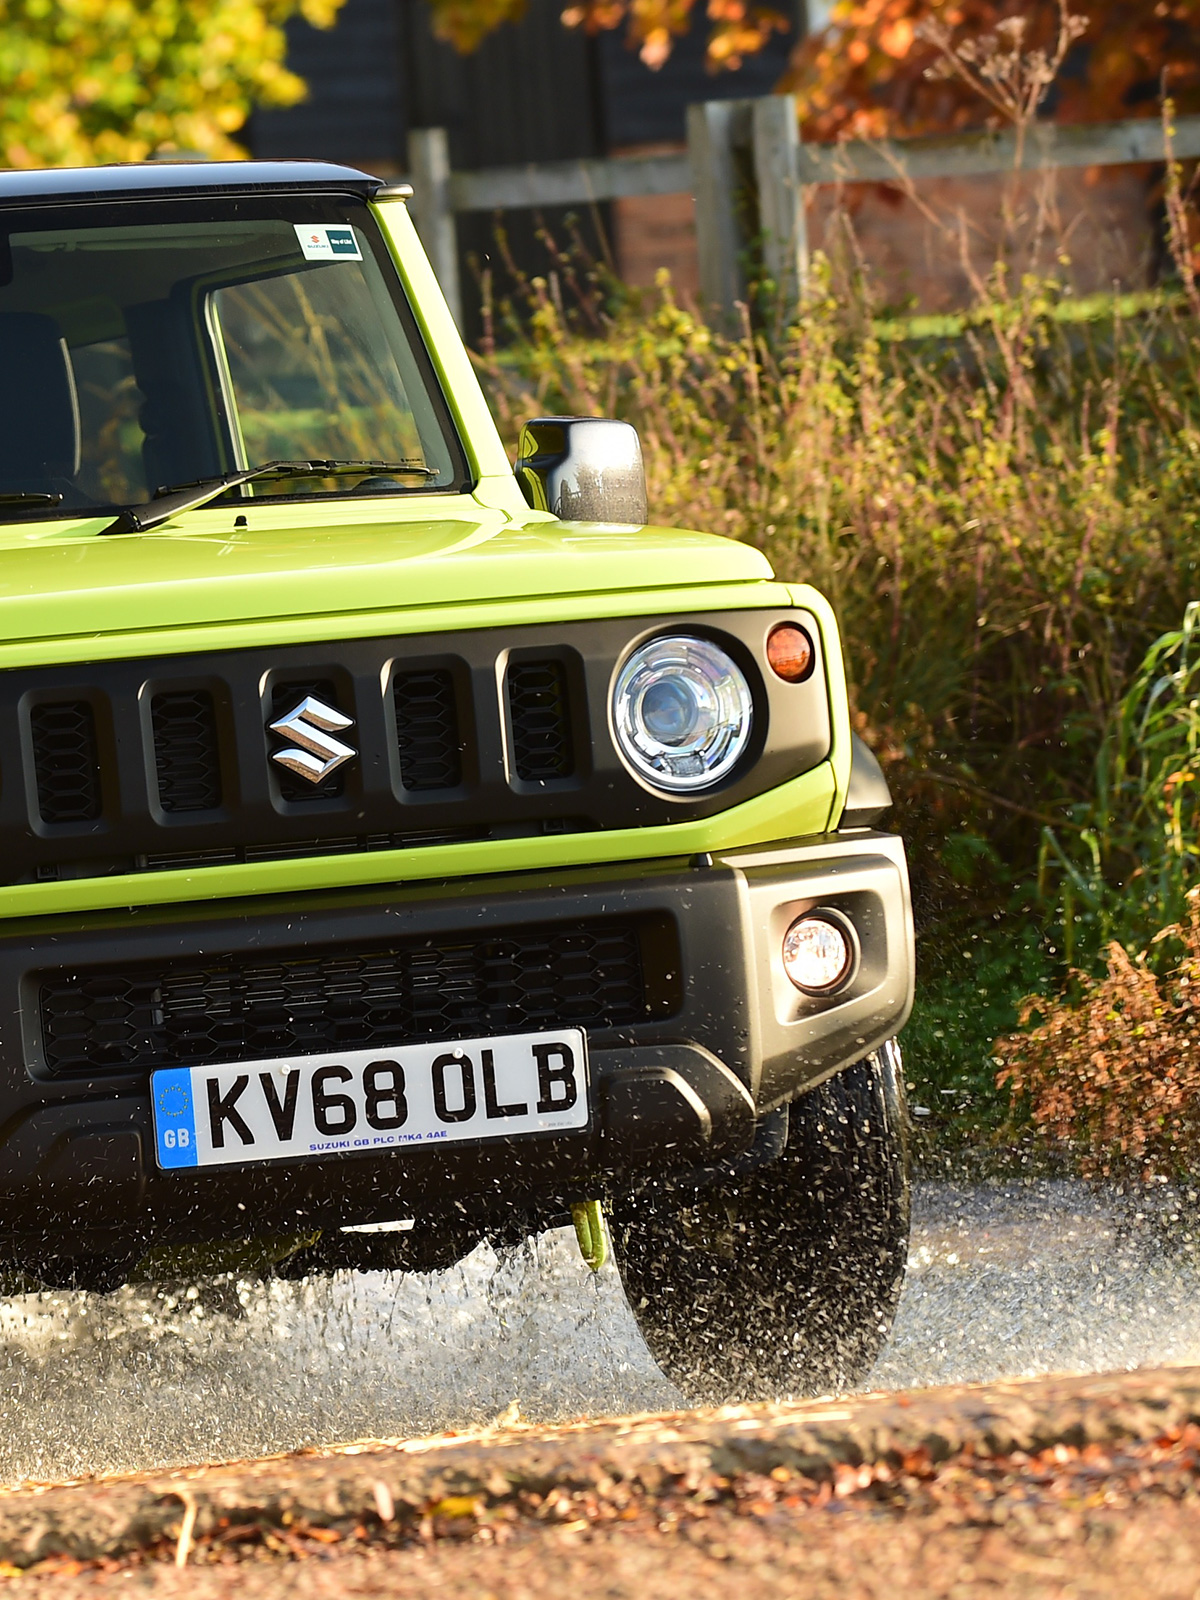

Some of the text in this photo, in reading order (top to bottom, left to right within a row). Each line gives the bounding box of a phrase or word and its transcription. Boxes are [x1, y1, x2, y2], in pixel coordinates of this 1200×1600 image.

[206, 1042, 577, 1149] KV68 OLB
[164, 1128, 189, 1148] GB
[309, 1130, 448, 1151] SUZUKI GB PLC MK4 4AE
